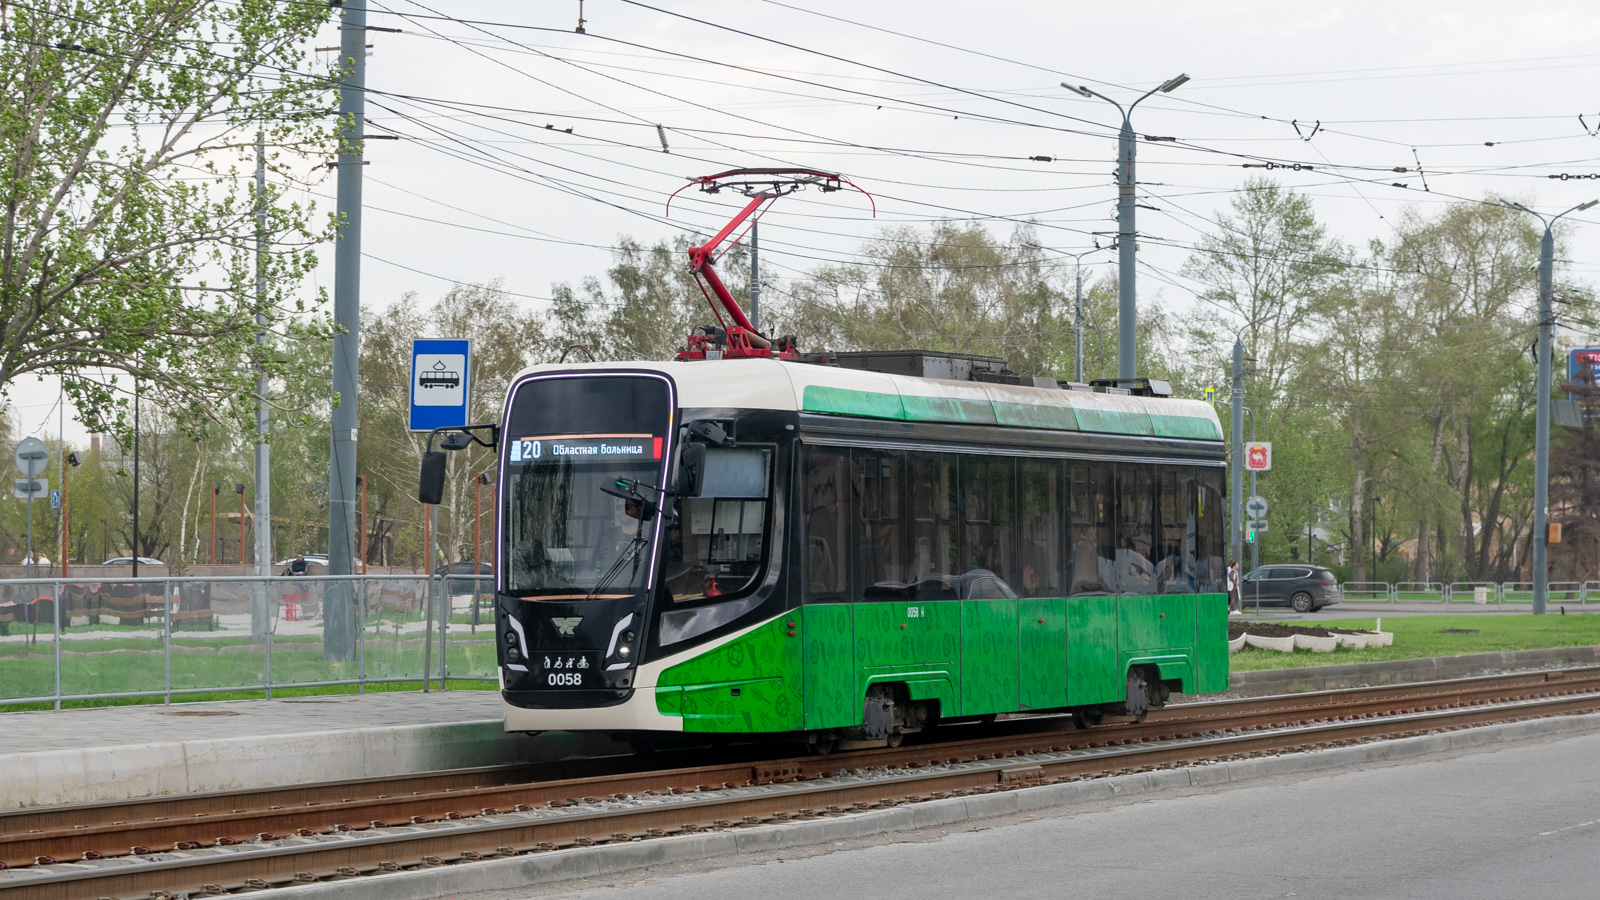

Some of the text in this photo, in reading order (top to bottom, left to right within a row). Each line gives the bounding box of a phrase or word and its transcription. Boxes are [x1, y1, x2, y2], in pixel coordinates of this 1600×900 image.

[522, 440, 541, 459] 20
[552, 444, 598, 455] Областная
[547, 673, 582, 686] 0058
